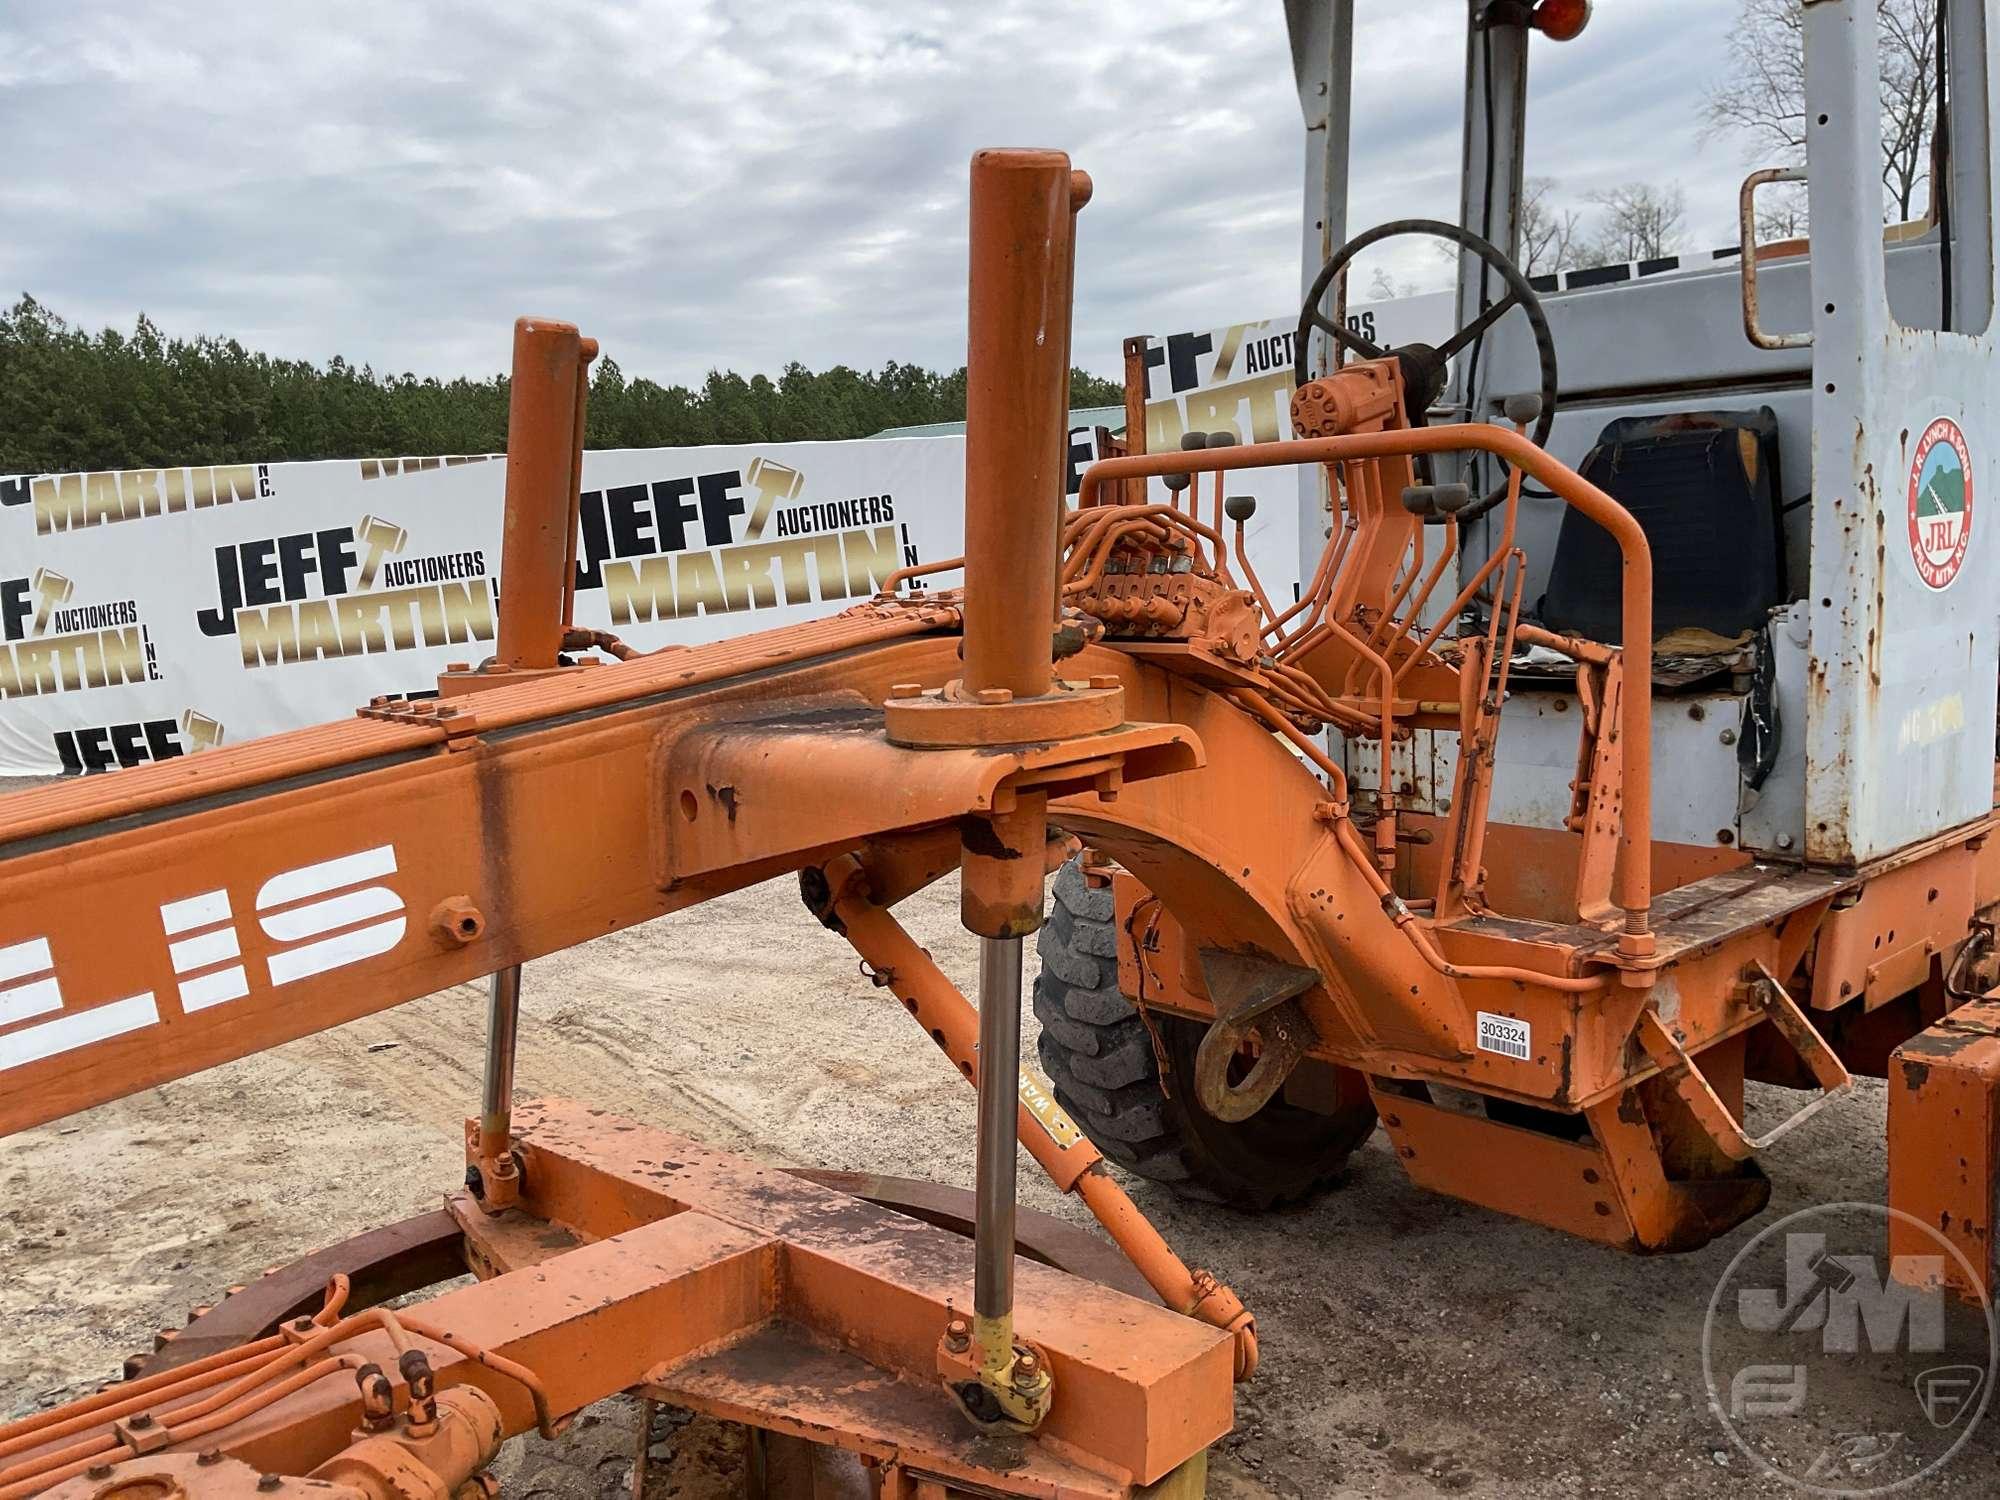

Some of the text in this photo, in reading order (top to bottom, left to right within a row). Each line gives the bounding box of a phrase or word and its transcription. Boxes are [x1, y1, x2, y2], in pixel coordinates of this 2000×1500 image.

[1922, 422, 1949, 453] LYNCH
[1954, 435, 1971, 482] SONS
[33, 467, 257, 536] MARTIN
[776, 494, 894, 537] AUCTIONEERS
[575, 470, 746, 591] JEFF
[1926, 520, 1957, 553] JRL
[196, 527, 358, 637] JEFF
[384, 550, 486, 588] AUCTIONEERS
[604, 525, 900, 626] MARTIN
[1913, 542, 1935, 583] PILOT
[54, 600, 137, 634] AUCTIONEERS
[238, 579, 495, 670] MARTIN
[142, 624, 163, 681] INC.
[1481, 1021, 1526, 1043] 303324
